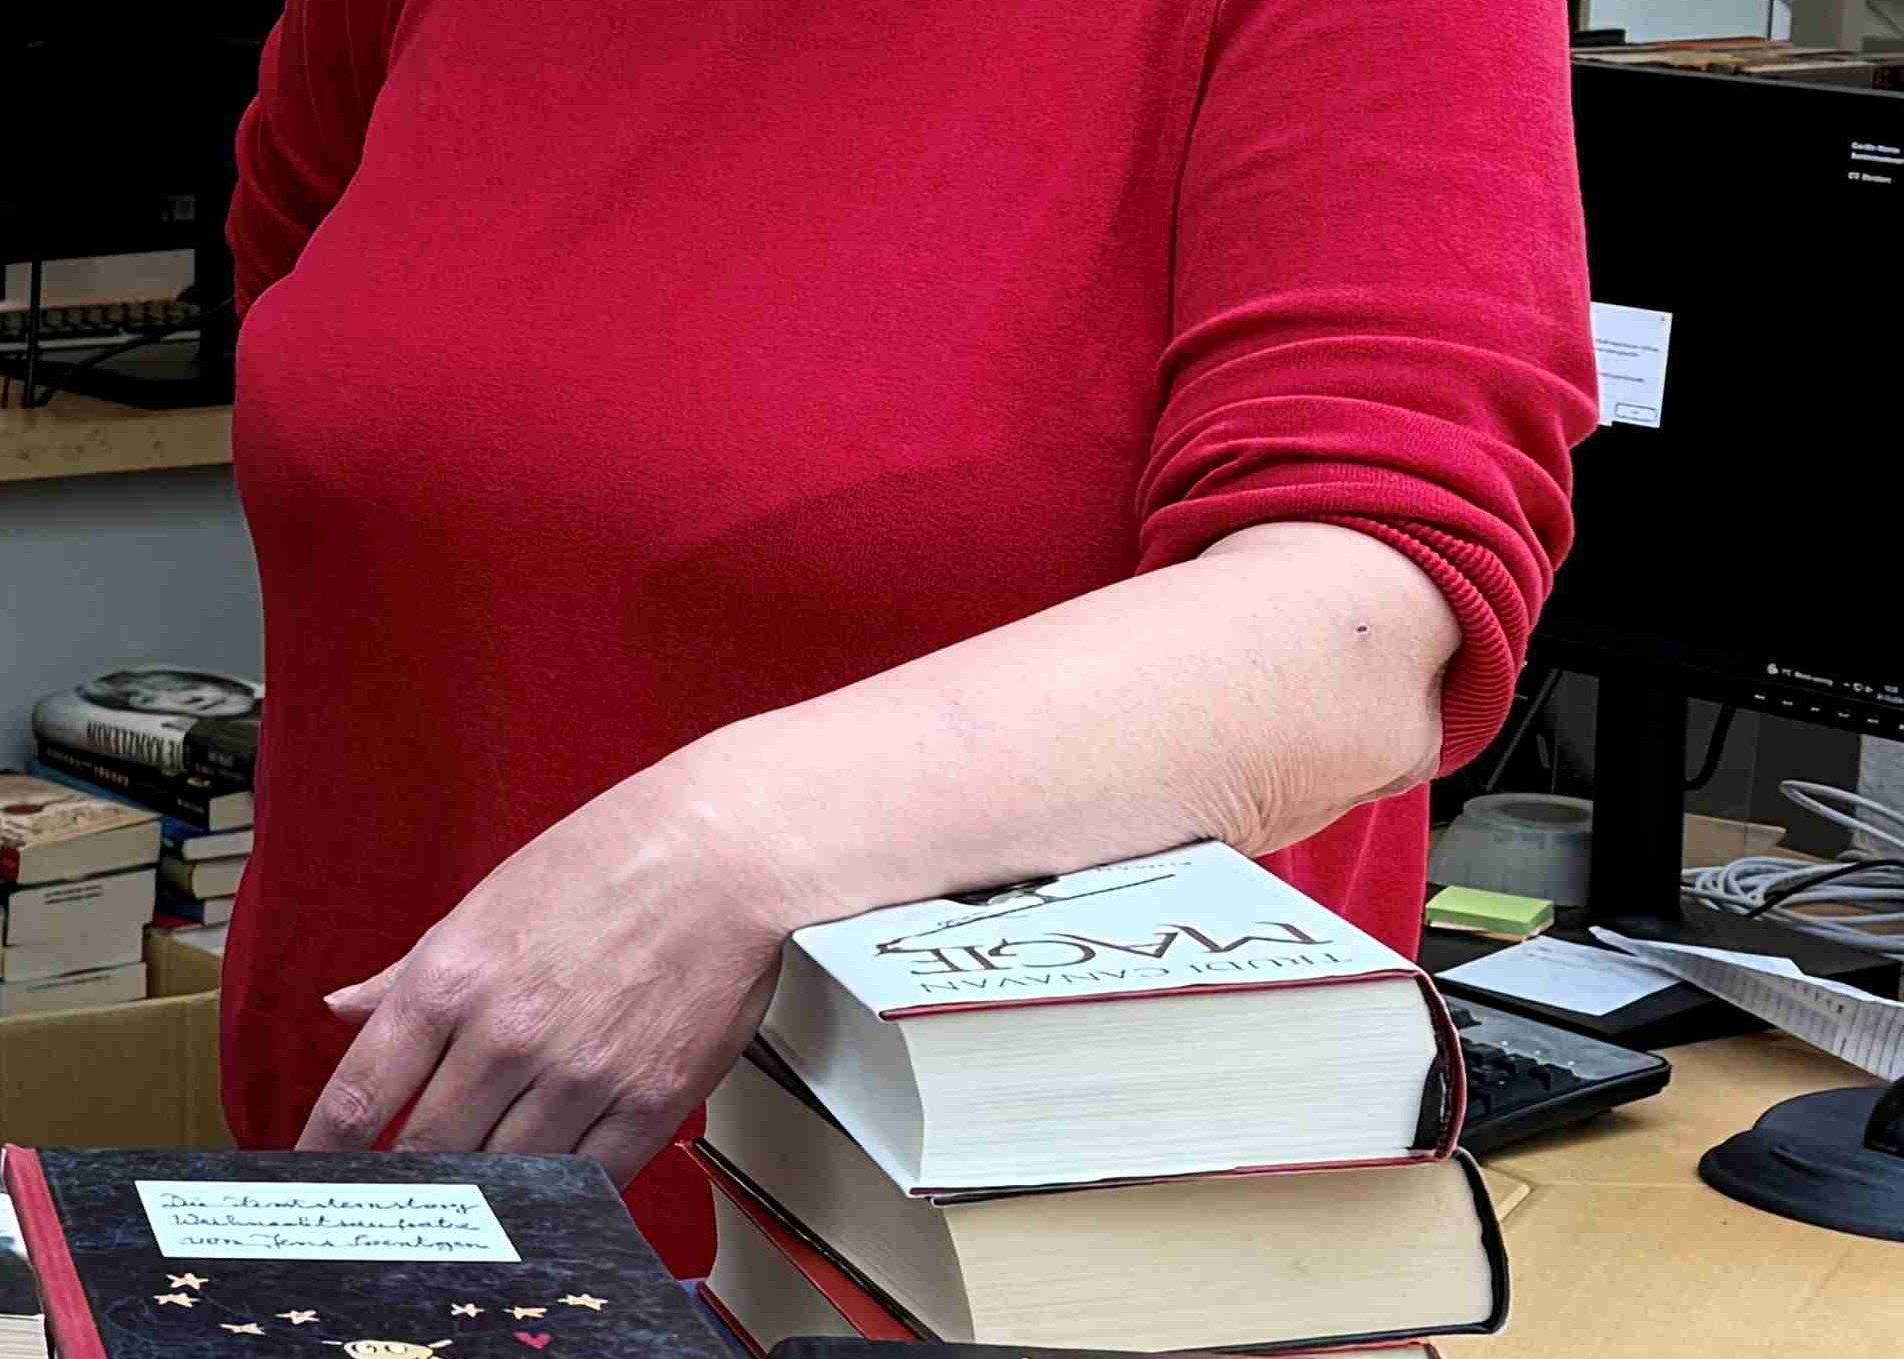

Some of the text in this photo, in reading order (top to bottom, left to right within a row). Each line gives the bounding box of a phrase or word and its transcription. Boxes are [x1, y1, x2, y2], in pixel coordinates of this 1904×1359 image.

[909, 920, 1334, 975] MAGIE
[920, 951, 1353, 994] TRUDI CANAVAN
